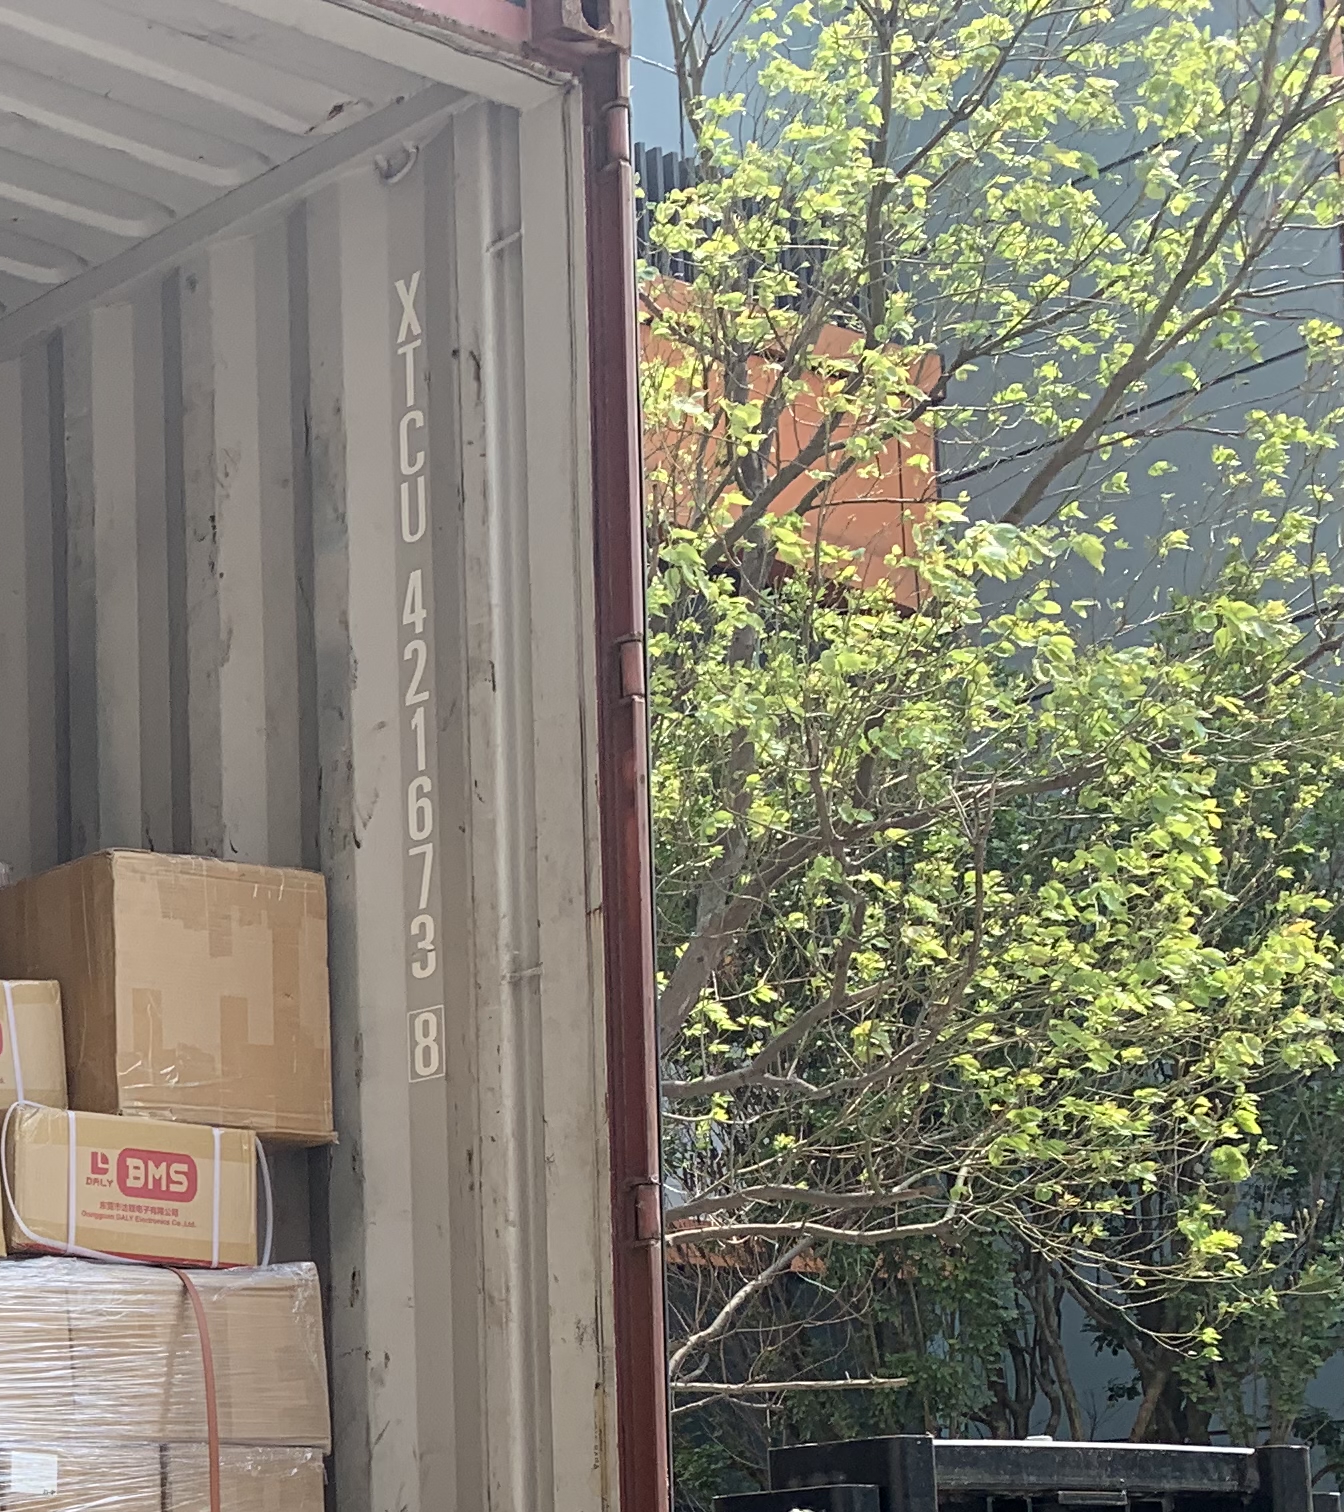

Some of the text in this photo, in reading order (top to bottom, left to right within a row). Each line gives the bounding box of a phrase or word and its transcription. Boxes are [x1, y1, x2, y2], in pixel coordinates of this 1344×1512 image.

[394, 270, 441, 1077] XTCU 421673 8
[86, 1177, 113, 1188] DALY
[126, 1158, 189, 1193] BMS
[116, 1213, 133, 1221] DALY
